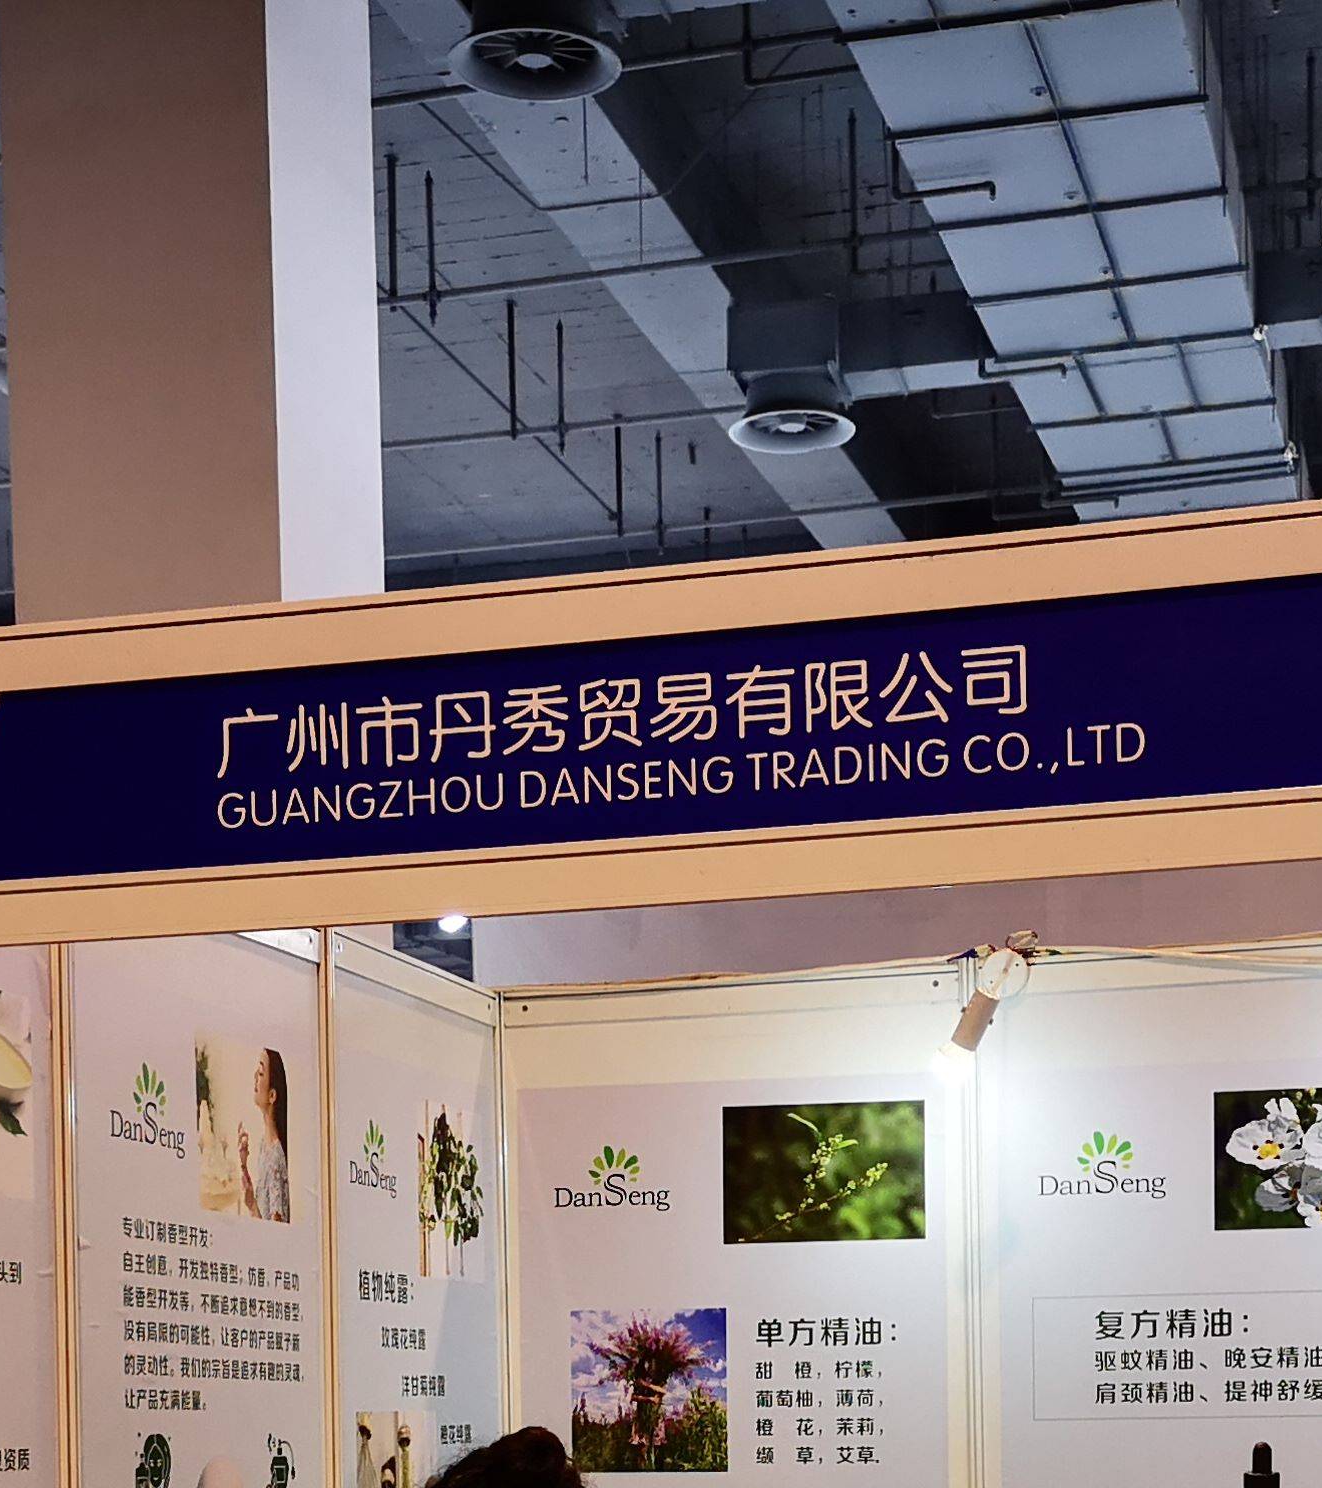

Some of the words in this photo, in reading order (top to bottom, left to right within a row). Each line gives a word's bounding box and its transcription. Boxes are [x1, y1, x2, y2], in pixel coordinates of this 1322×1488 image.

[217, 643, 1028, 779] 广州市丹秀贸易有限公司
[216, 771, 505, 831] GUANGZHOU
[520, 755, 736, 809] DANSENG
[745, 738, 950, 792] TRADING
[109, 1101, 186, 1160] DanSeng
[349, 1152, 398, 1199] DanSeng
[554, 1173, 671, 1211] DanSeng
[1037, 1159, 1167, 1199] DanSeng
[755, 1316, 899, 1348] 单方精油：
[1094, 1307, 1252, 1341] 复方精油：
